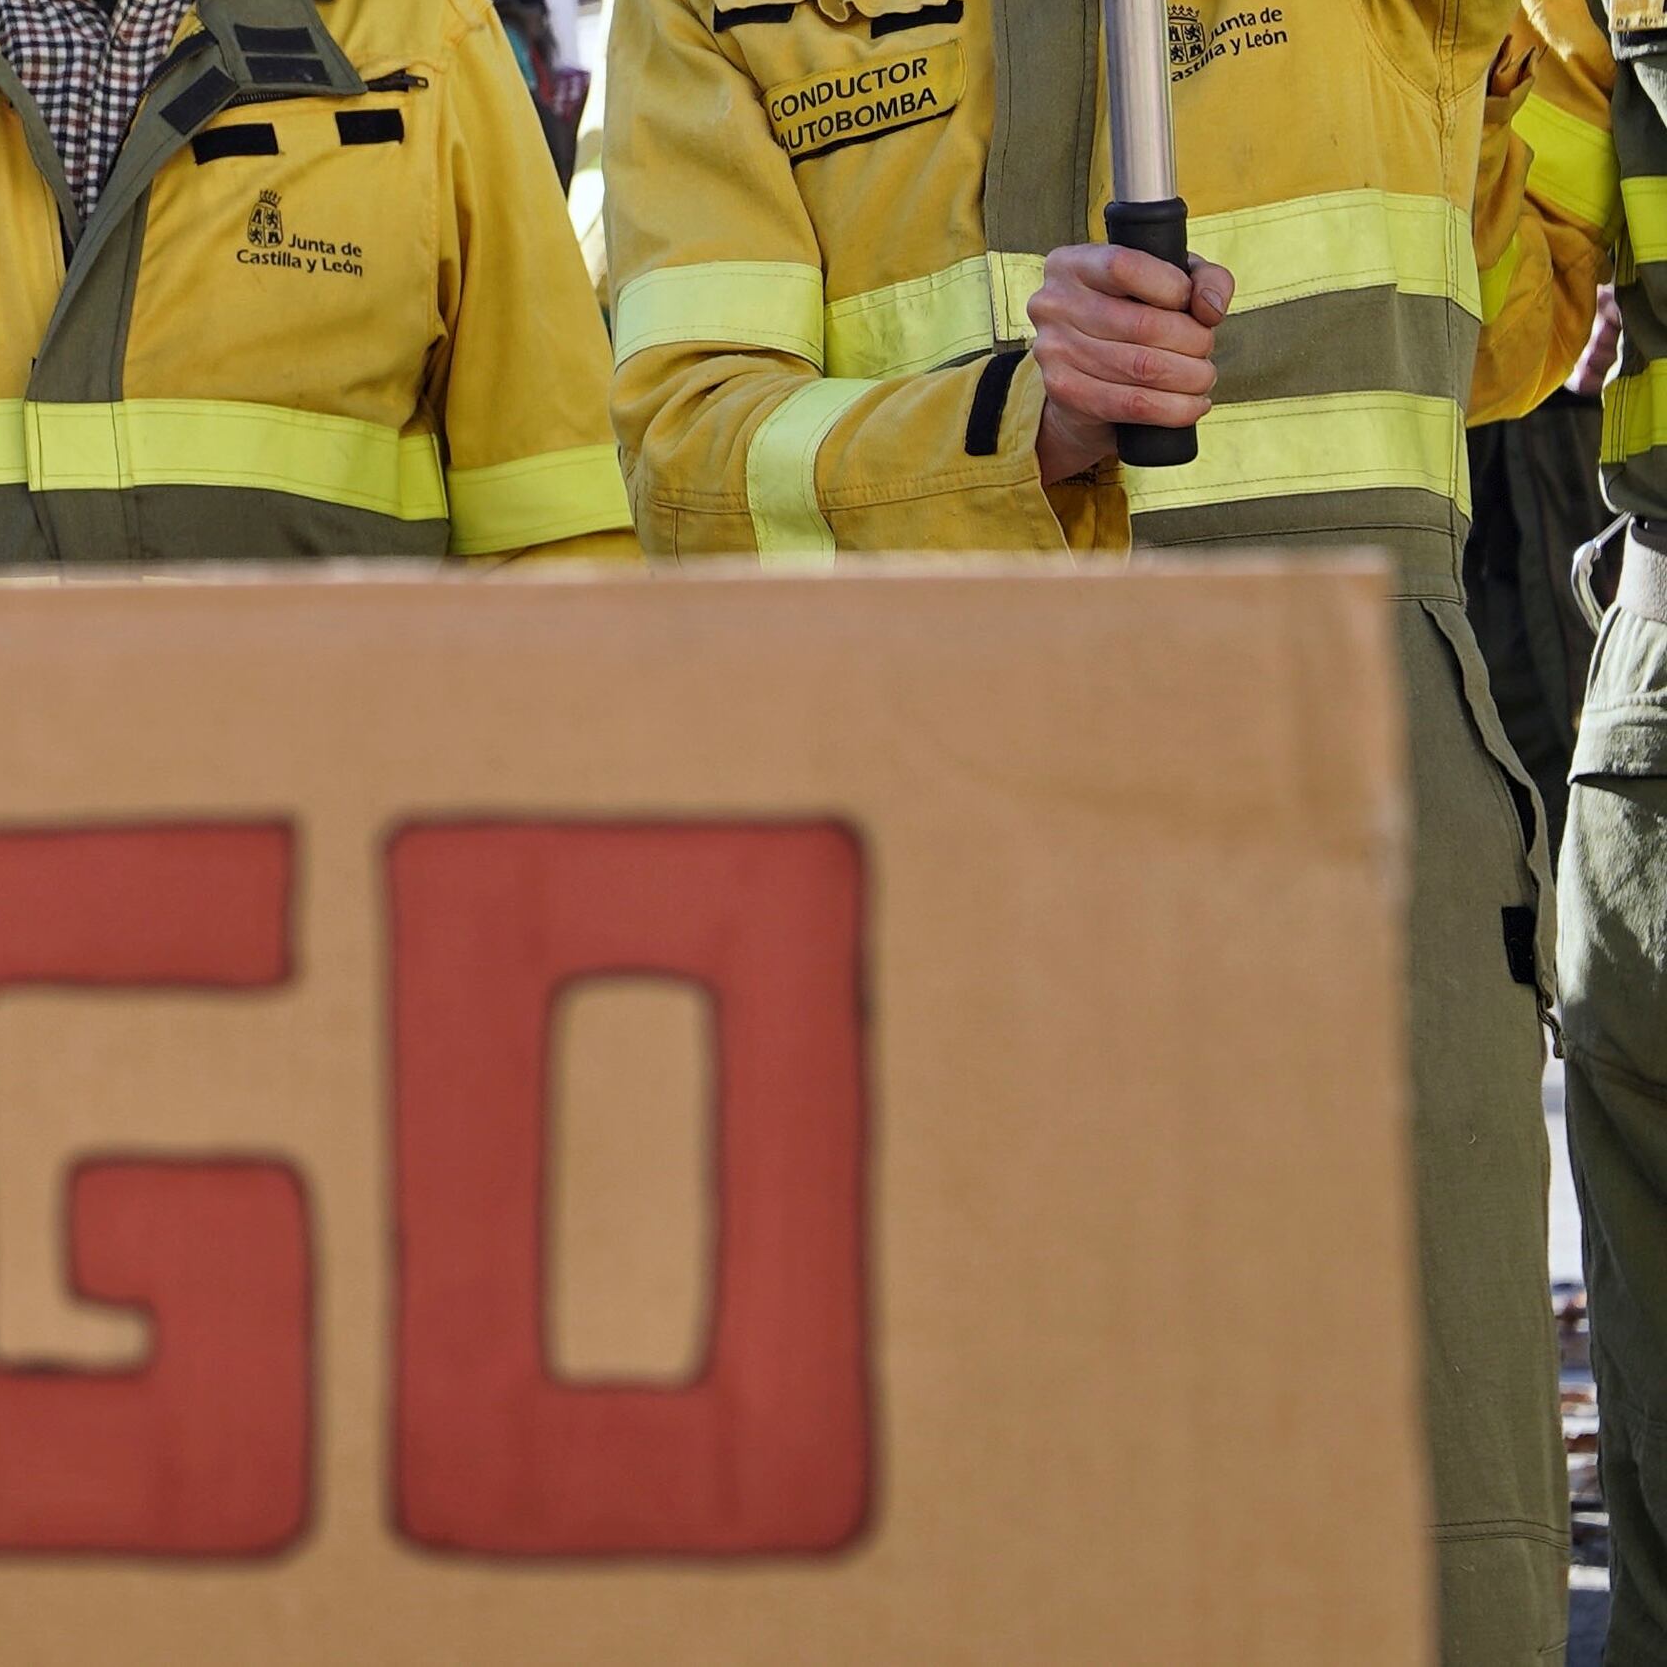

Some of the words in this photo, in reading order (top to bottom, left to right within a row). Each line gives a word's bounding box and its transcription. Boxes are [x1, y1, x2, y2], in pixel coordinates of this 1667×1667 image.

[1260, 7, 1283, 24] de
[1171, 43, 1227, 83] astilla
[1230, 37, 1241, 57] y
[1246, 29, 1288, 50] León
[771, 57, 929, 123] CONDUCTOR
[778, 87, 938, 153] AUTOBOMBA
[236, 249, 302, 269] Castilla
[306, 258, 317, 273] y
[322, 257, 363, 277] León
[288, 234, 336, 254] Junta
[341, 232, 362, 257] de
